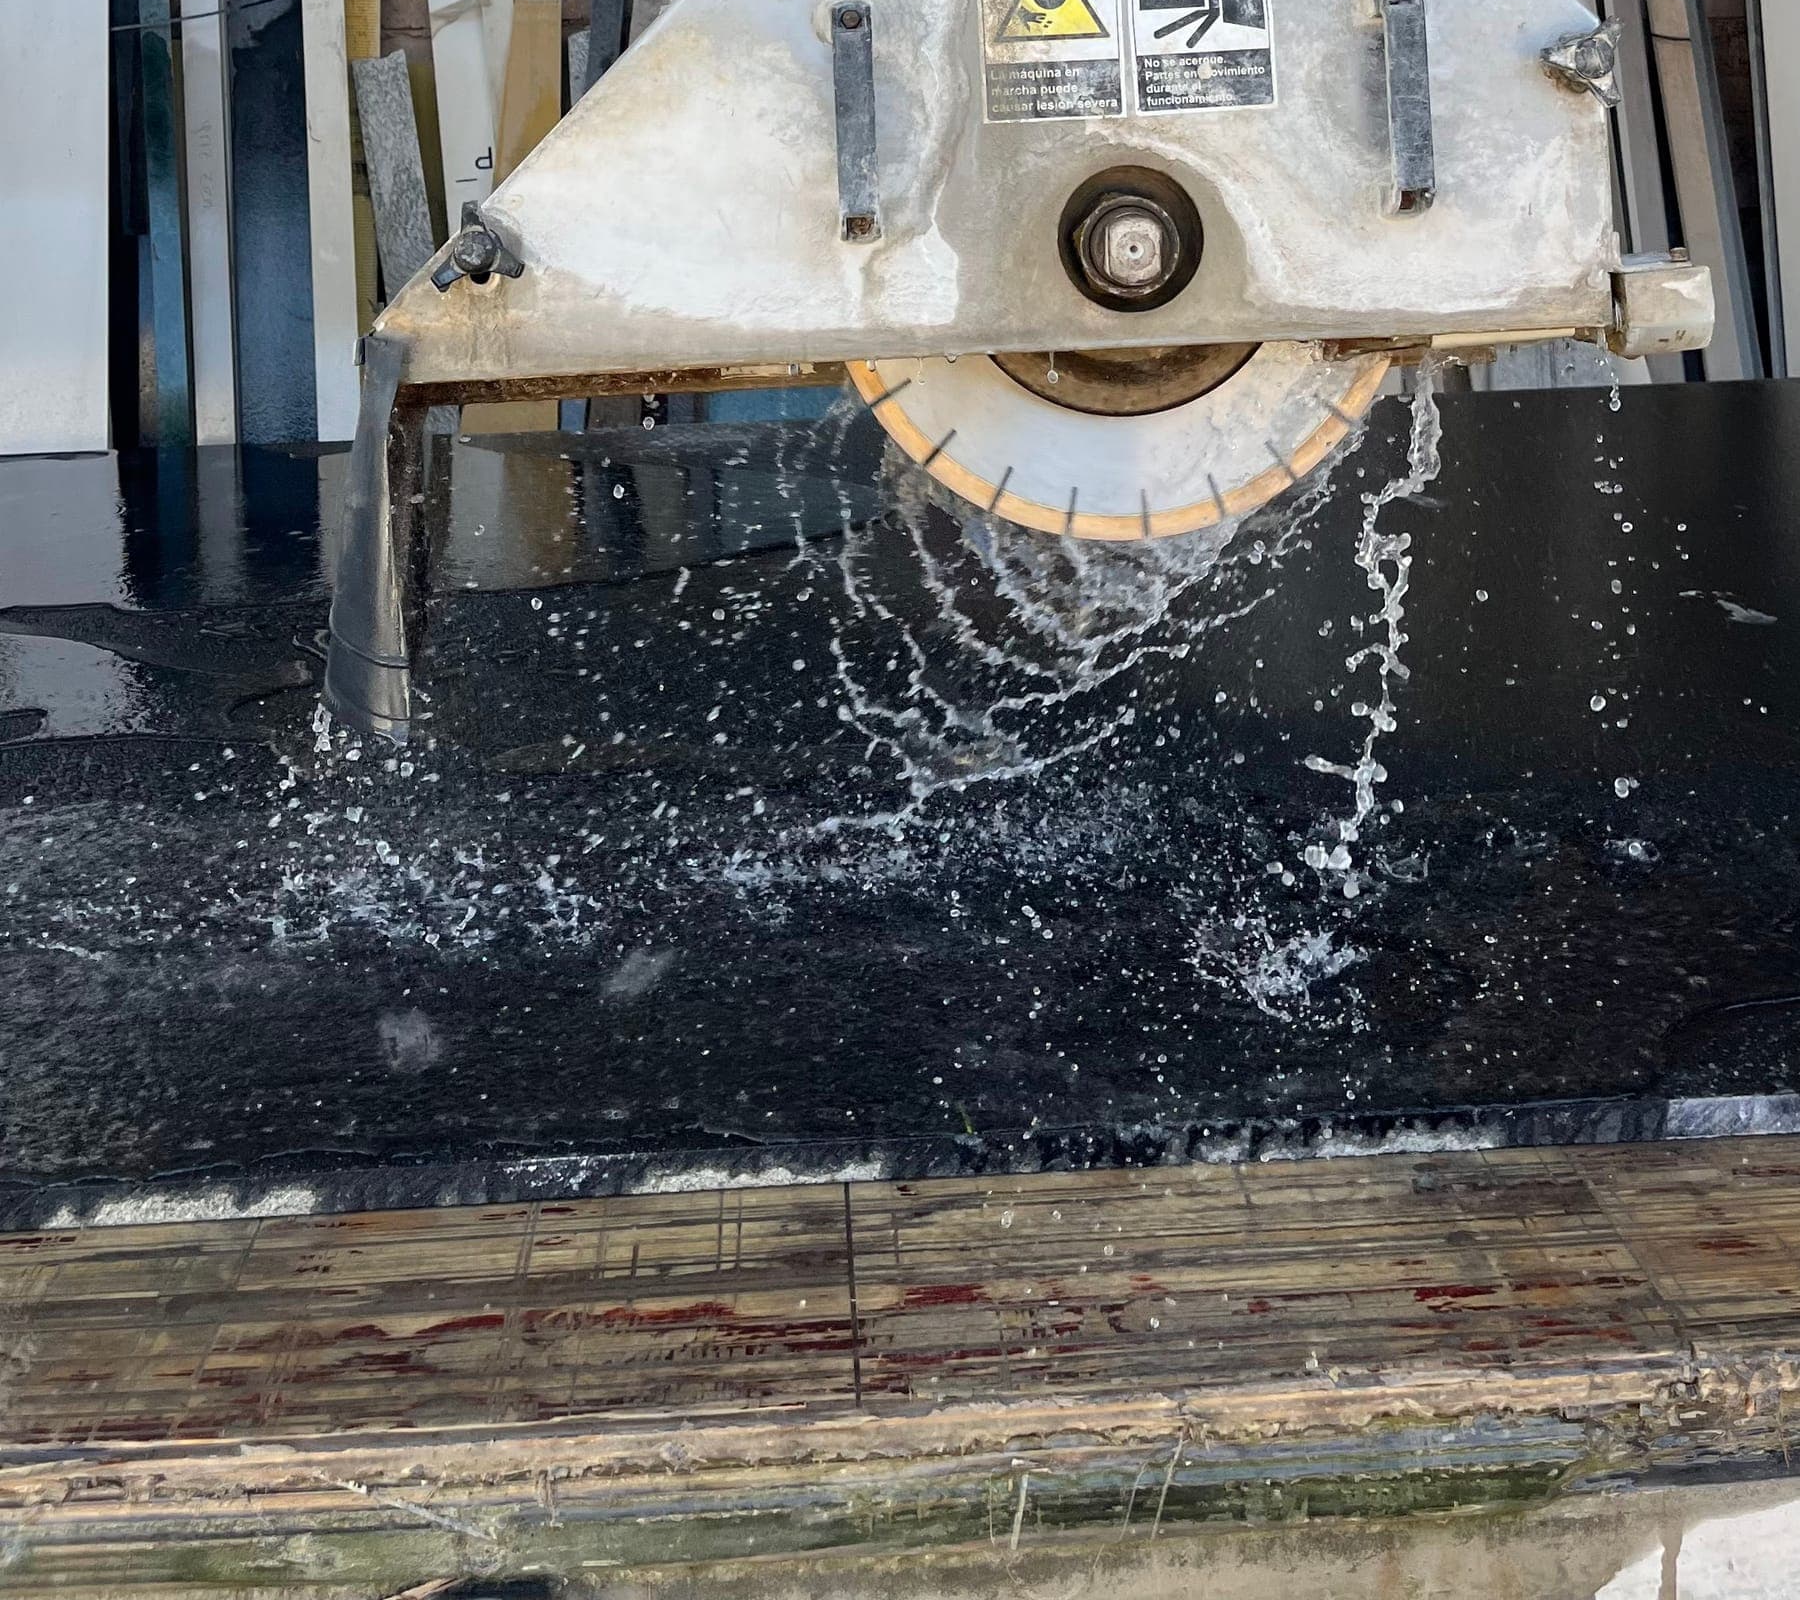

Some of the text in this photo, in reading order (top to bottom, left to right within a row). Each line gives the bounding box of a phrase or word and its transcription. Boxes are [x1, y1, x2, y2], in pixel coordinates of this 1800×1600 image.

[1144, 57, 1160, 68] No
[1009, 68, 1062, 81] máquina
[1065, 67, 1080, 77] en
[1144, 65, 1265, 81] Partes en ovimiento
[991, 83, 1078, 96] marcha puede
[1077, 99, 1118, 109] severa
